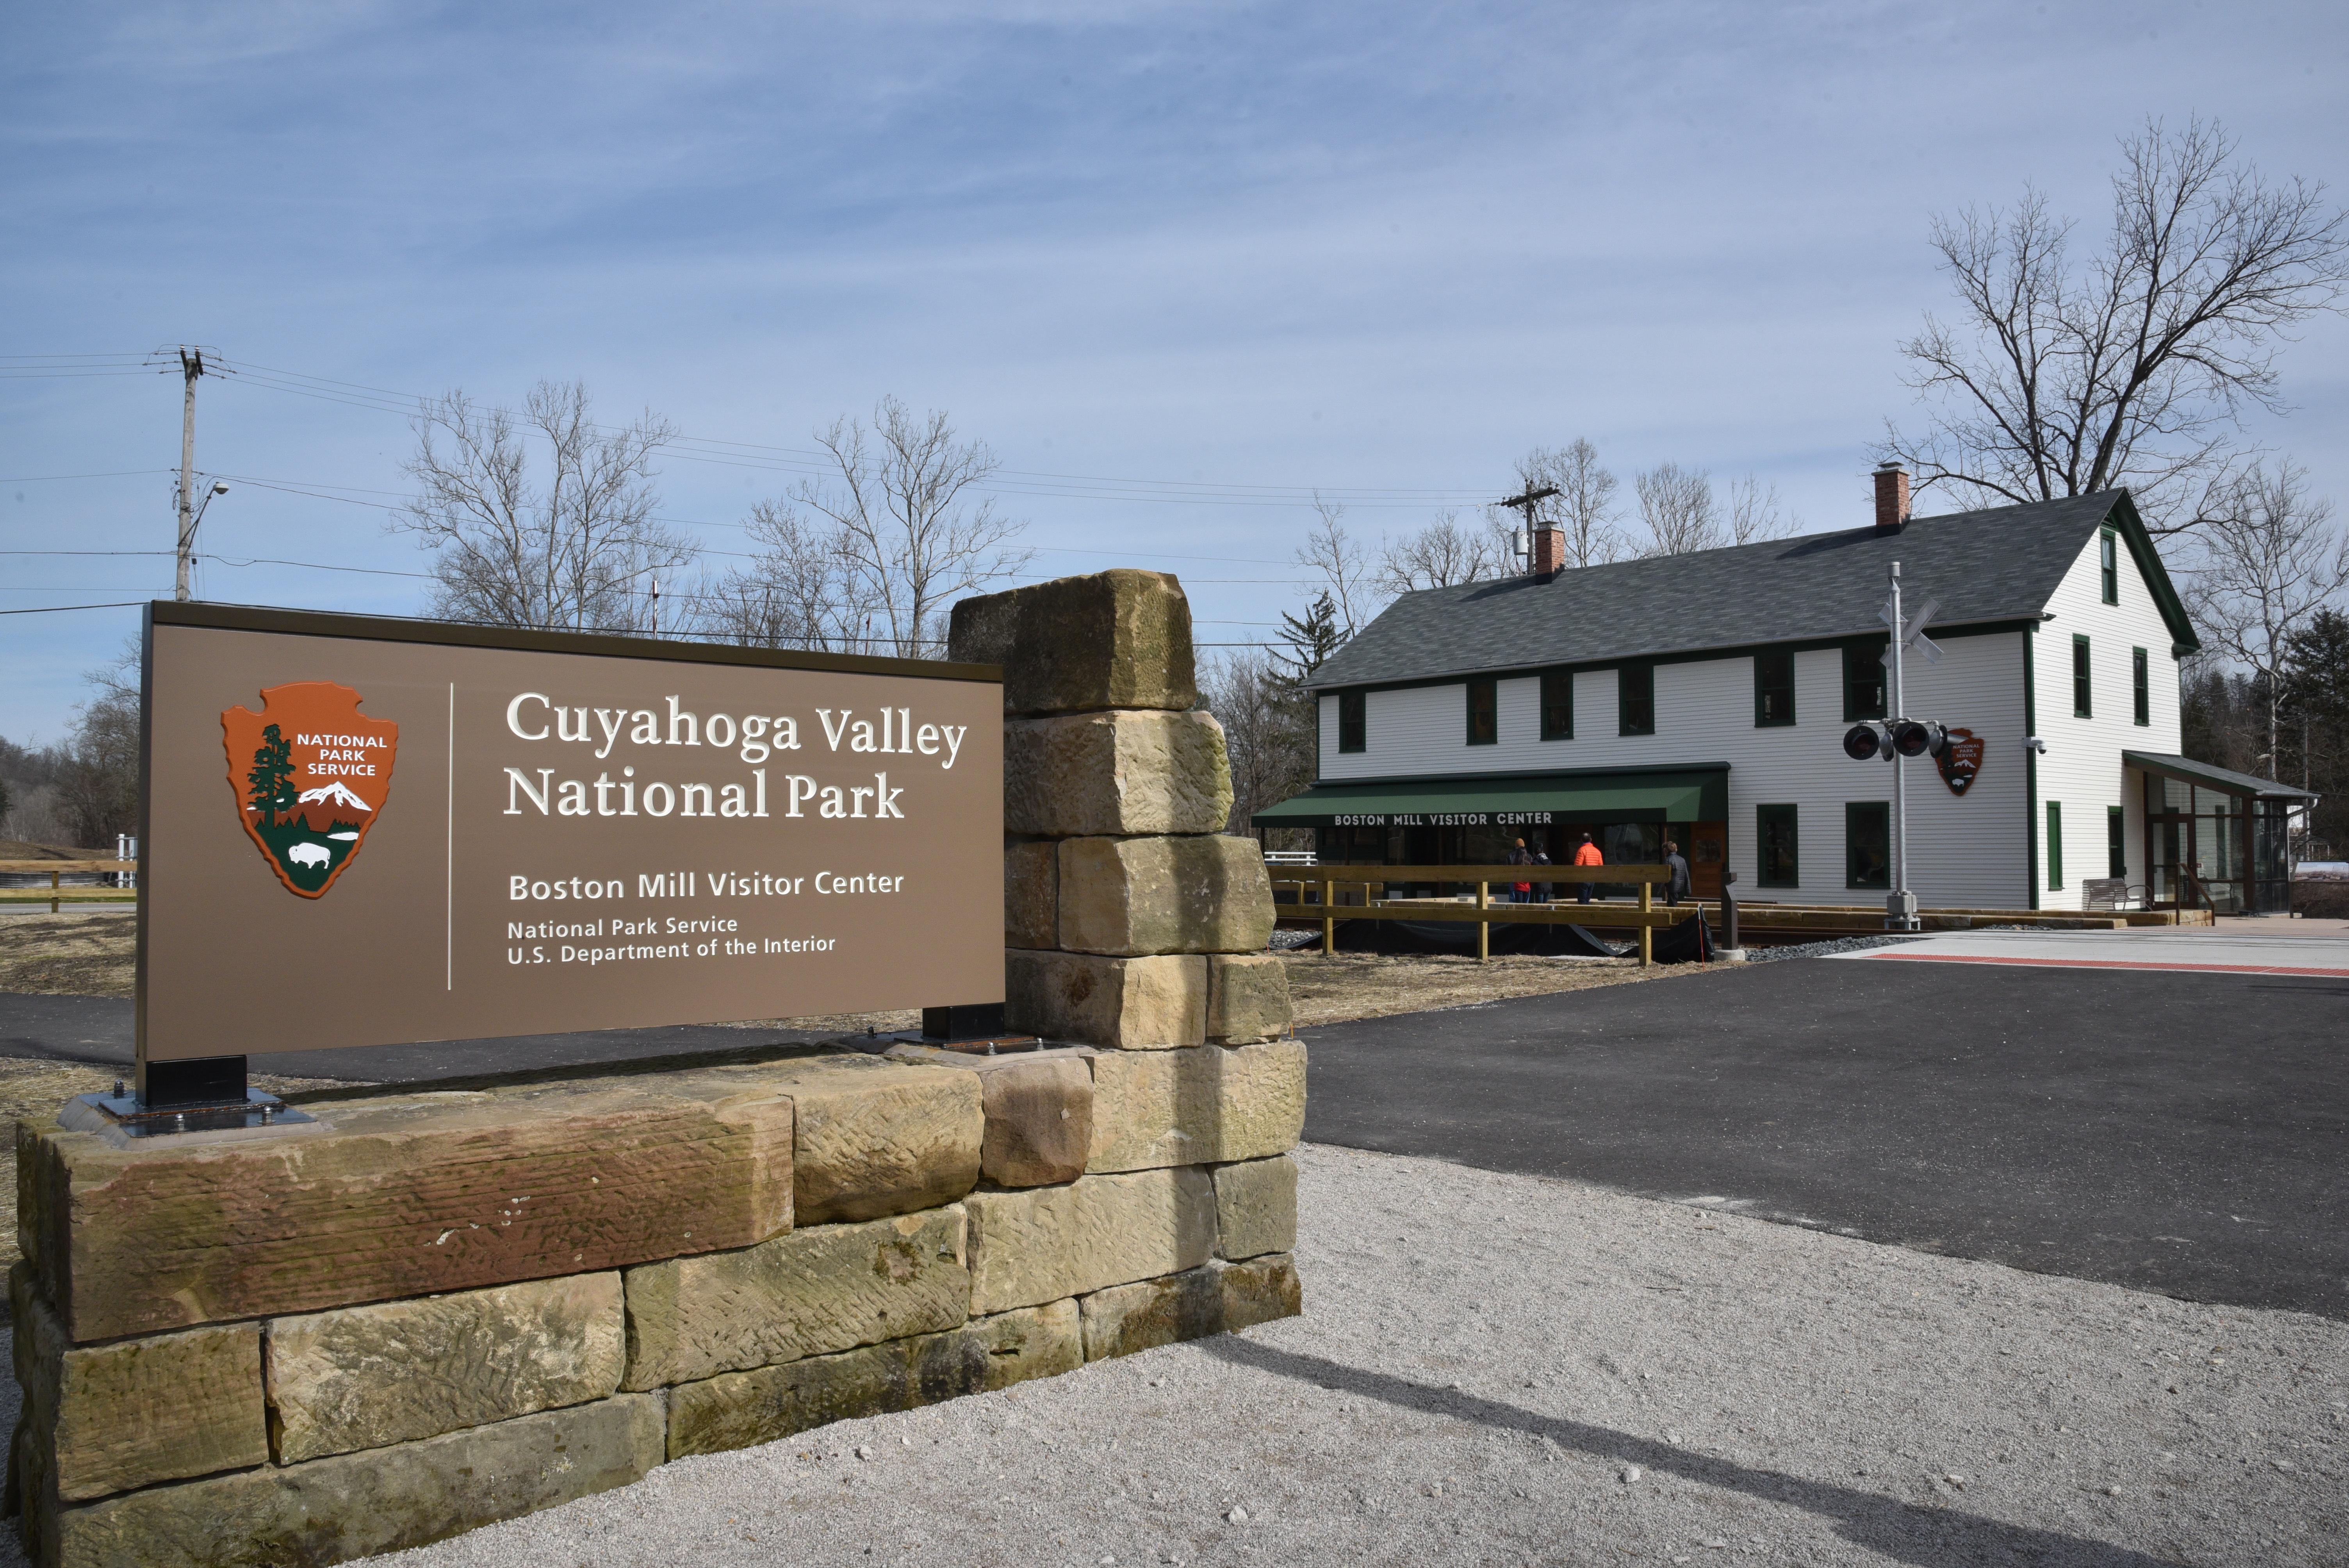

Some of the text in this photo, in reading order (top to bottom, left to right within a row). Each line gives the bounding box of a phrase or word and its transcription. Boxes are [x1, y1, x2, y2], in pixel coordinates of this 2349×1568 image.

[297, 734, 387, 748] NATIONAL
[506, 692, 968, 770] Cuyahoga Valley
[319, 749, 365, 762] PARK
[307, 763, 376, 776] SERVICE
[503, 766, 905, 819] National Park
[1335, 812, 1552, 826] BOSTON MILL VISITOR CENTER
[510, 871, 904, 900] Boston Mill Visitor Center
[508, 915, 738, 939] National Park Service
[508, 935, 836, 966] U.S. Department of the Interior
